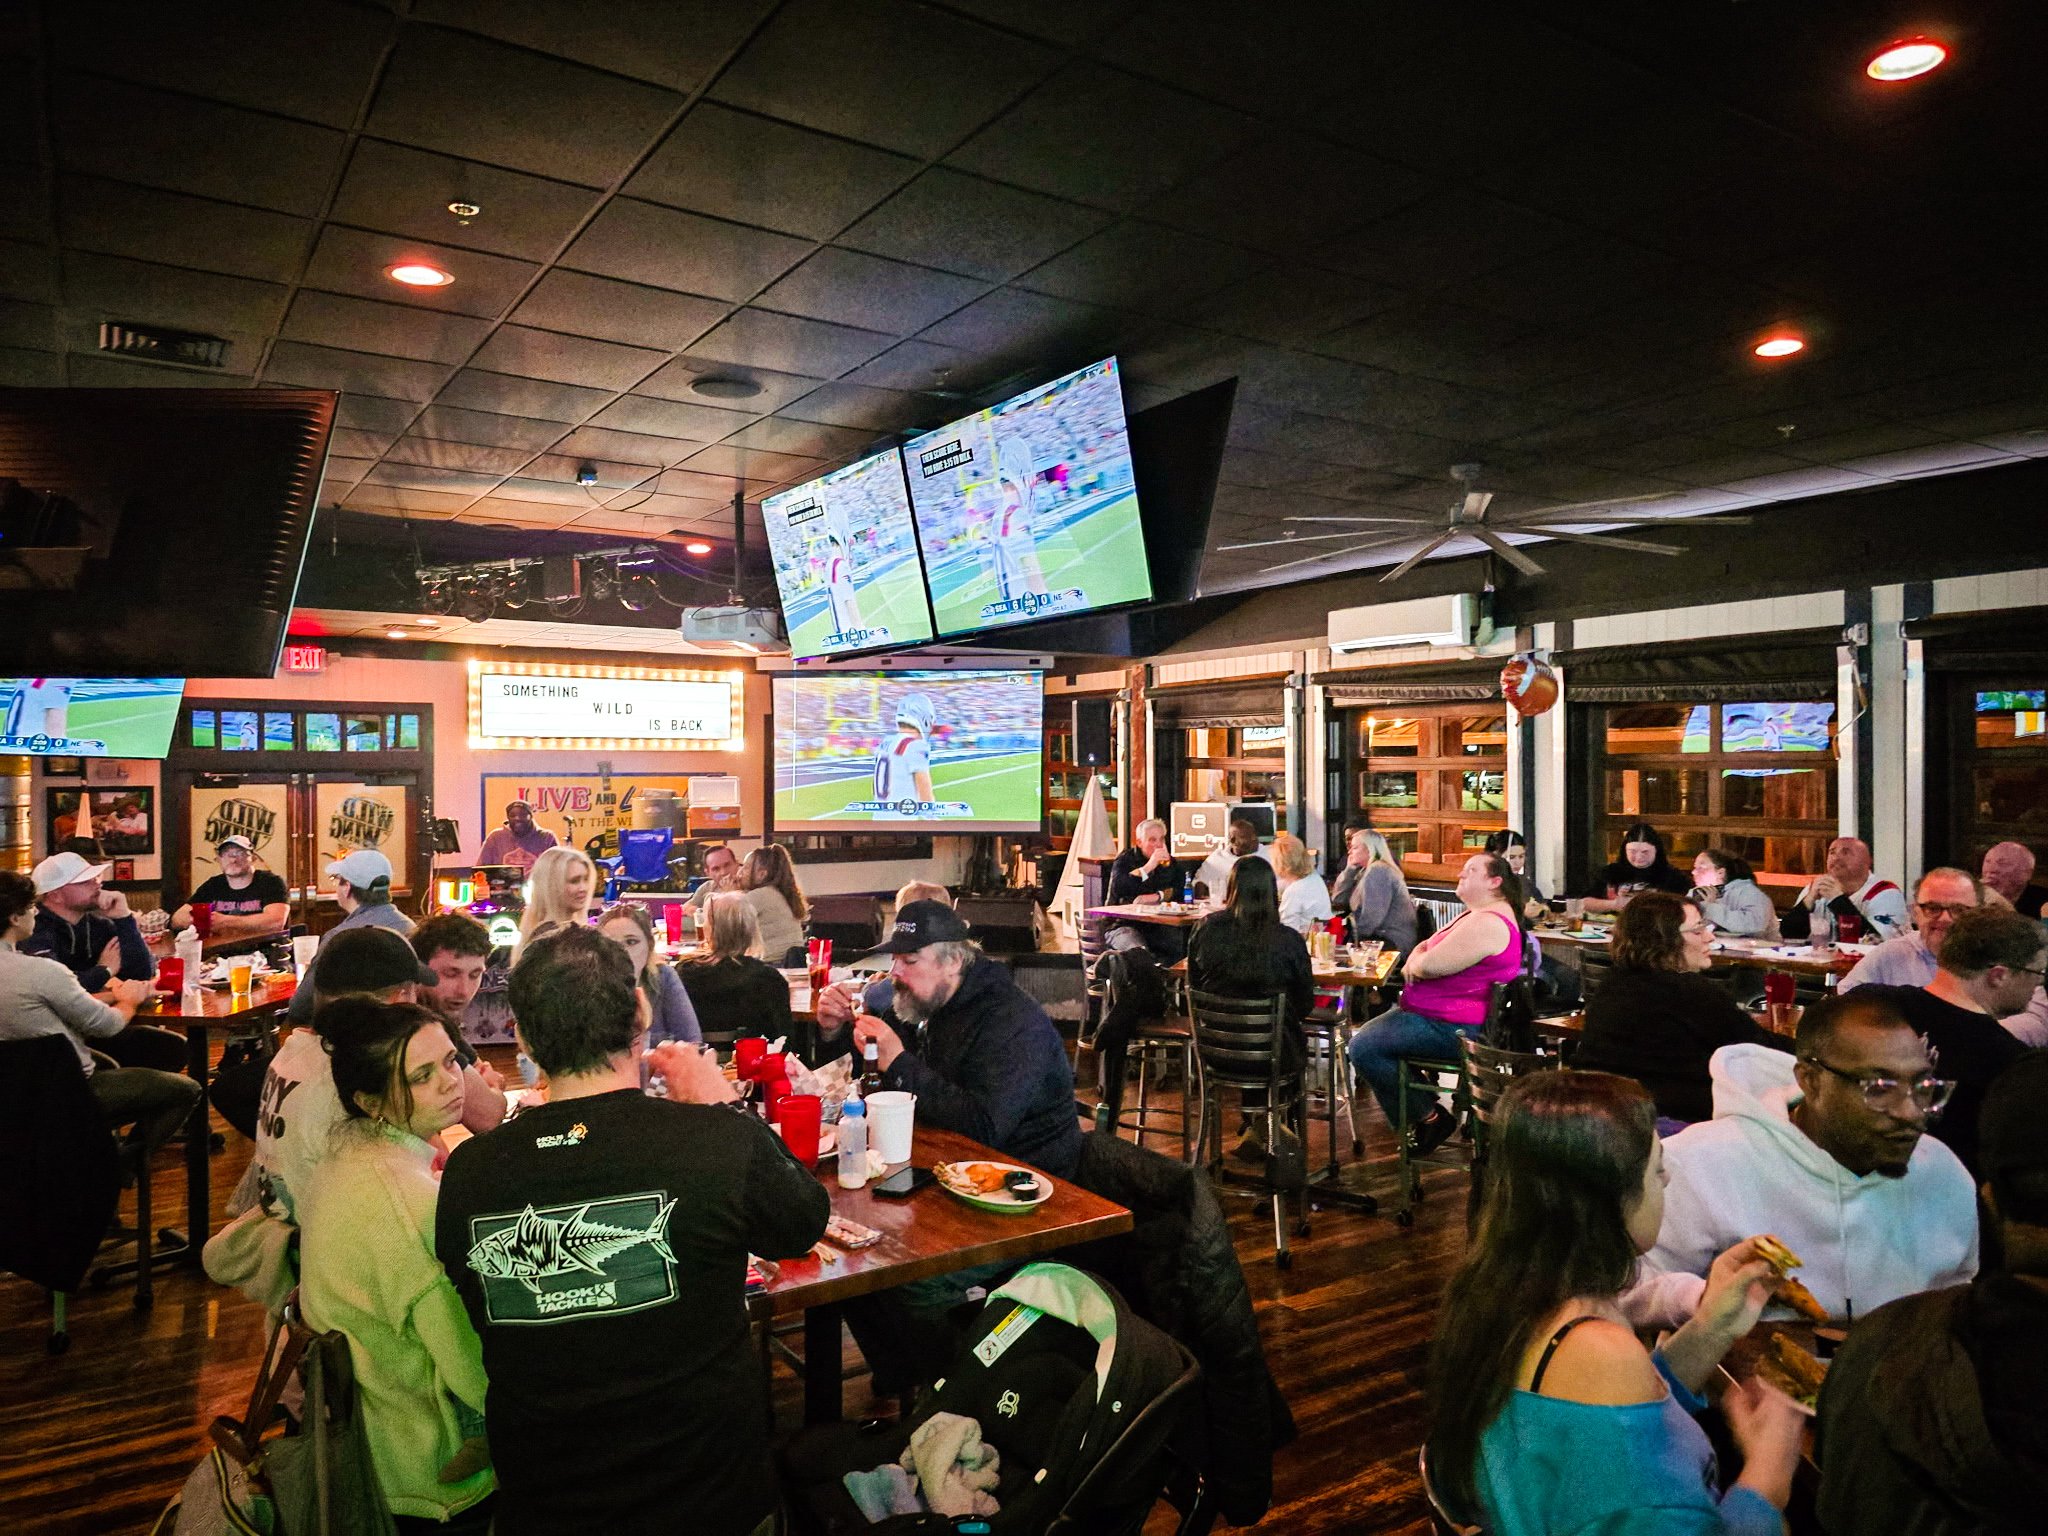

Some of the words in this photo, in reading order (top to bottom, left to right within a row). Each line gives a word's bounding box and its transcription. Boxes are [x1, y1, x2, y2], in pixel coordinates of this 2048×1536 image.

[1012, 601, 1019, 610] 6
[1041, 595, 1048, 605] 0
[290, 647, 322, 669] EXIT
[503, 684, 578, 698] SOMETHING
[593, 702, 633, 715] WILD
[649, 719, 661, 731] IS
[671, 719, 703, 731] BACK
[15, 738, 24, 746] 6
[54, 739, 63, 747] 0
[518, 787, 592, 813] LIVE
[596, 793, 617, 805] AND
[590, 817, 613, 827] THE
[616, 816, 632, 826] WI
[536, 1286, 596, 1304] HOOK
[537, 1296, 597, 1314] TACKLE
